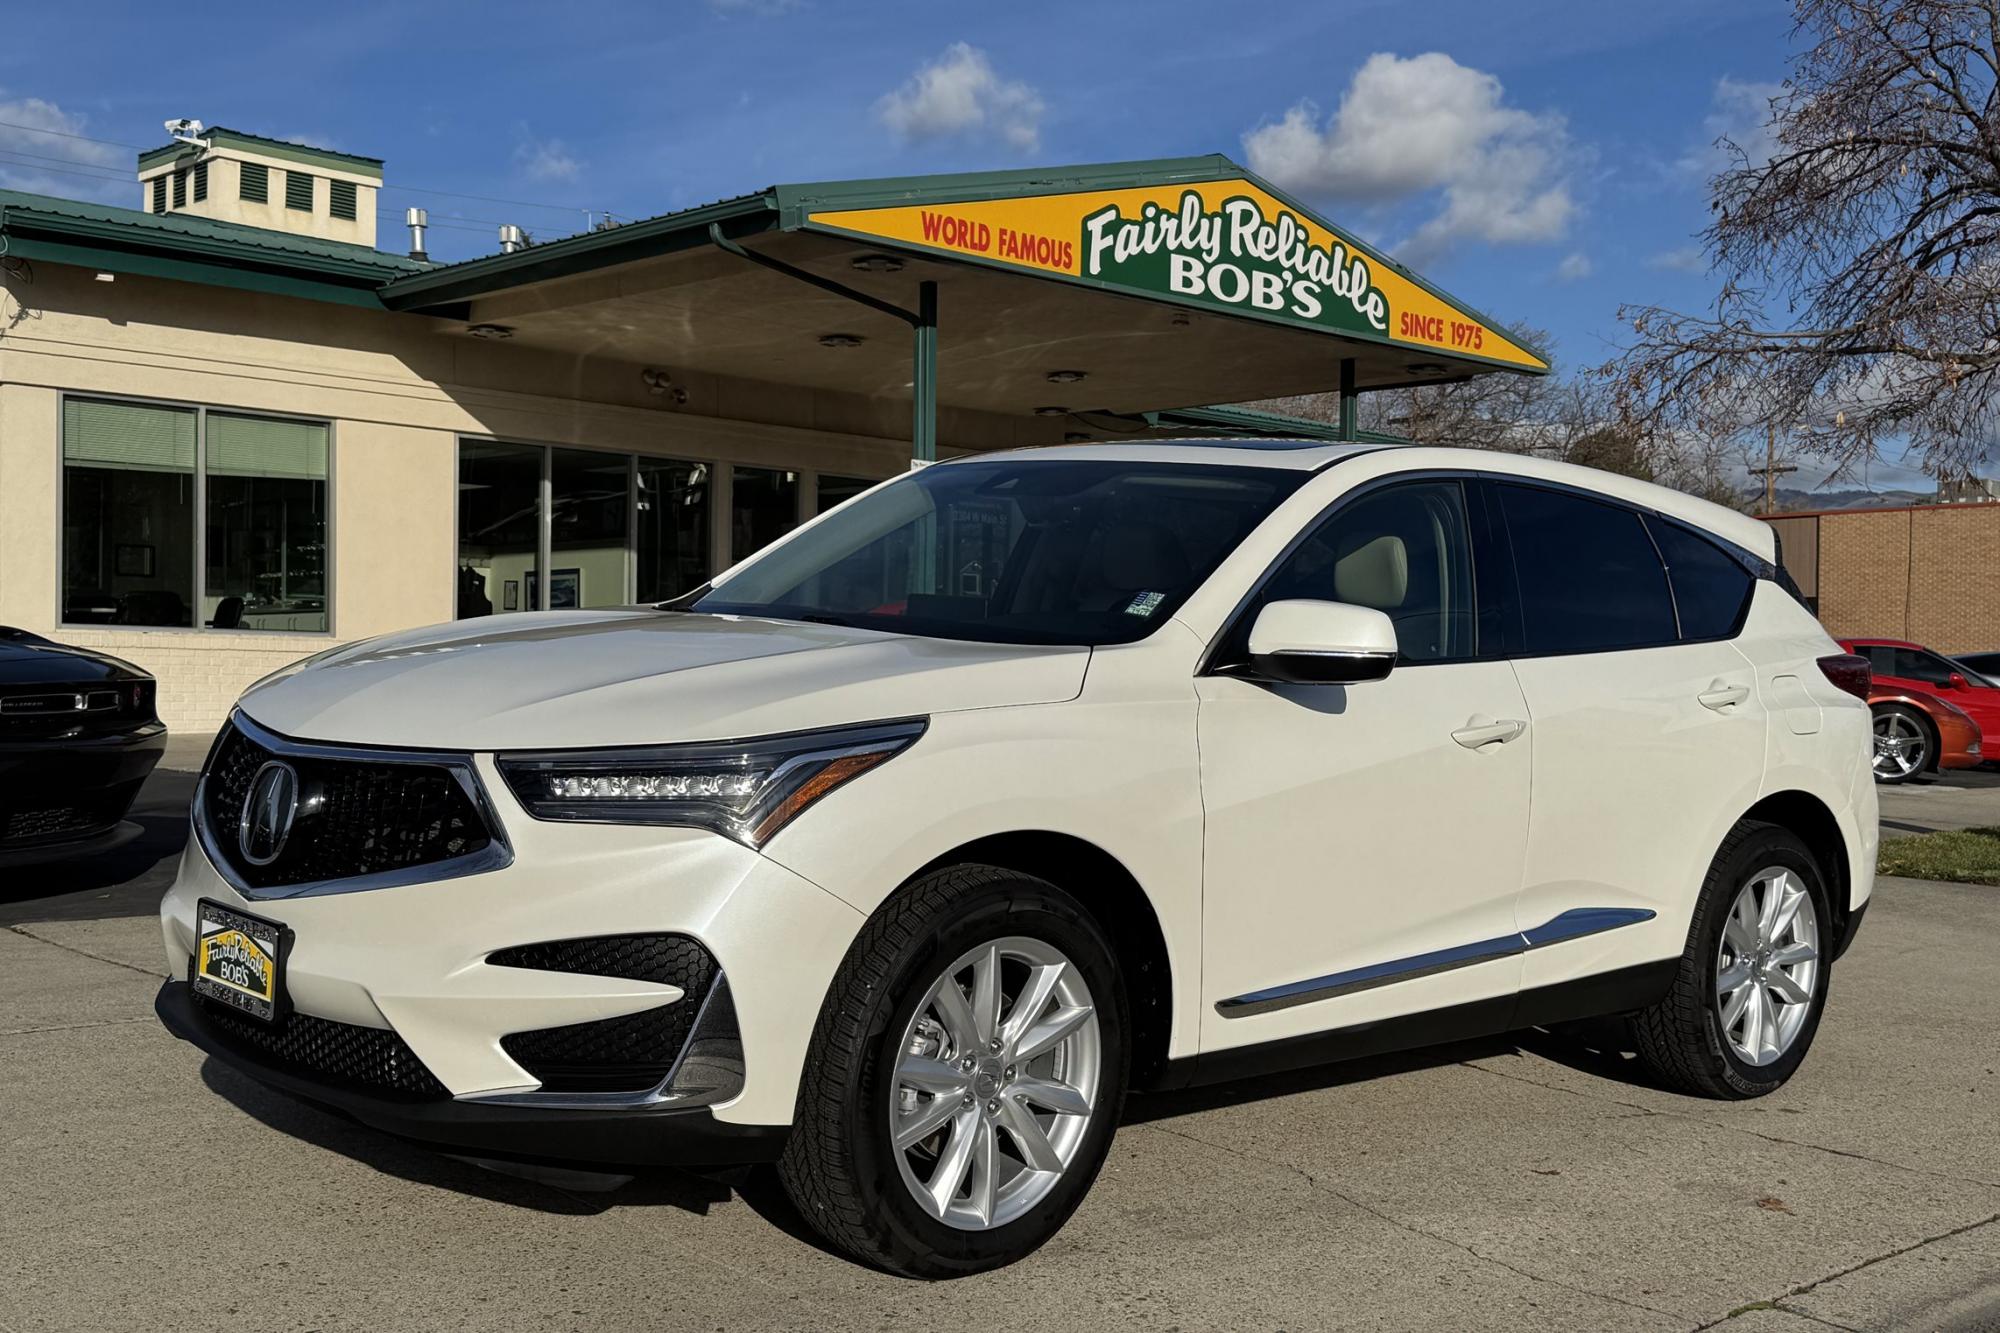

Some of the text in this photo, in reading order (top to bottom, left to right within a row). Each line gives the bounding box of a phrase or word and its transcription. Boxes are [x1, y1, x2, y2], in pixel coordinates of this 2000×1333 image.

[921, 211, 1072, 269] WORLD FAMOUS
[1087, 194, 1386, 329] Fairly Reliable
[1170, 253, 1322, 318] BOB'S
[1401, 311, 1483, 350] SINCE 1975
[207, 936, 236, 964] Fairly
[221, 961, 249, 987] BOB'S
